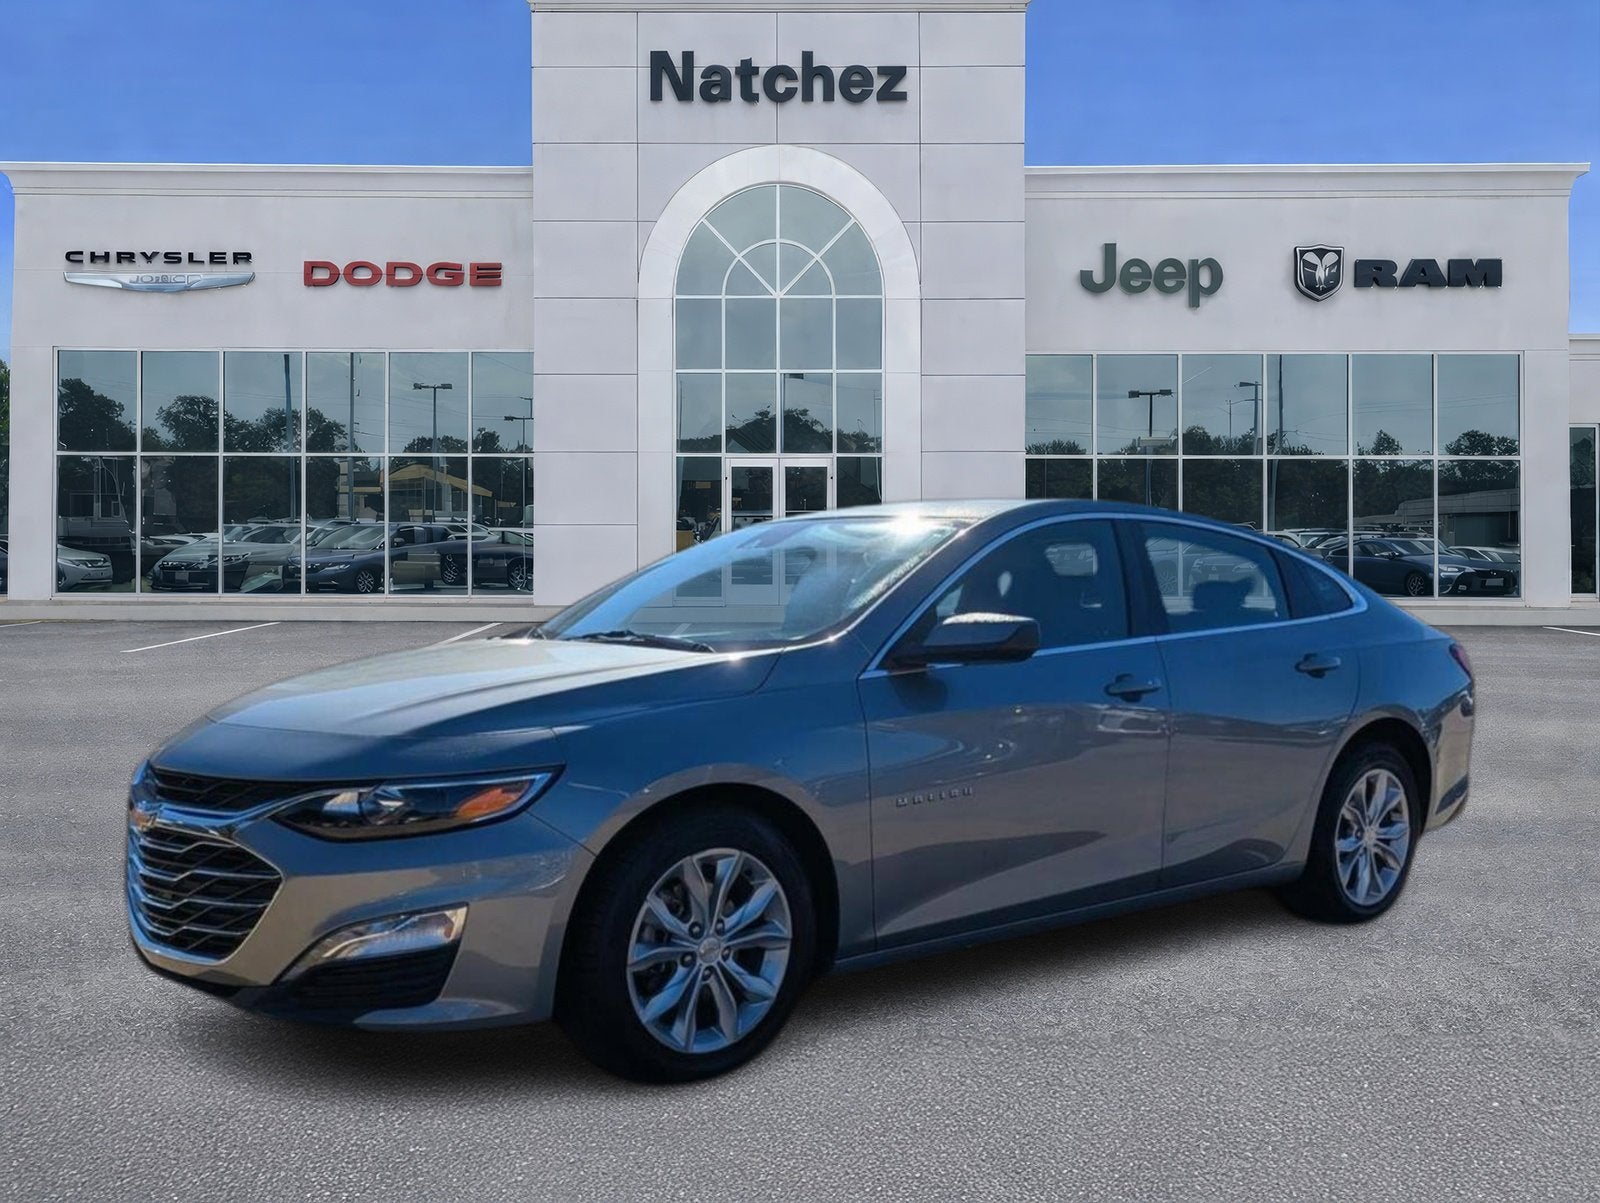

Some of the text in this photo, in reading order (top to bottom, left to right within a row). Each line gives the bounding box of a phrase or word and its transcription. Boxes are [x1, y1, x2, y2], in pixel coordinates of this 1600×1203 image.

[650, 50, 908, 103] Natchez
[65, 250, 252, 265] CHRYSLER
[304, 261, 502, 287] DODGE
[1080, 243, 1224, 309] Jeep
[1353, 258, 1503, 289] RAM
